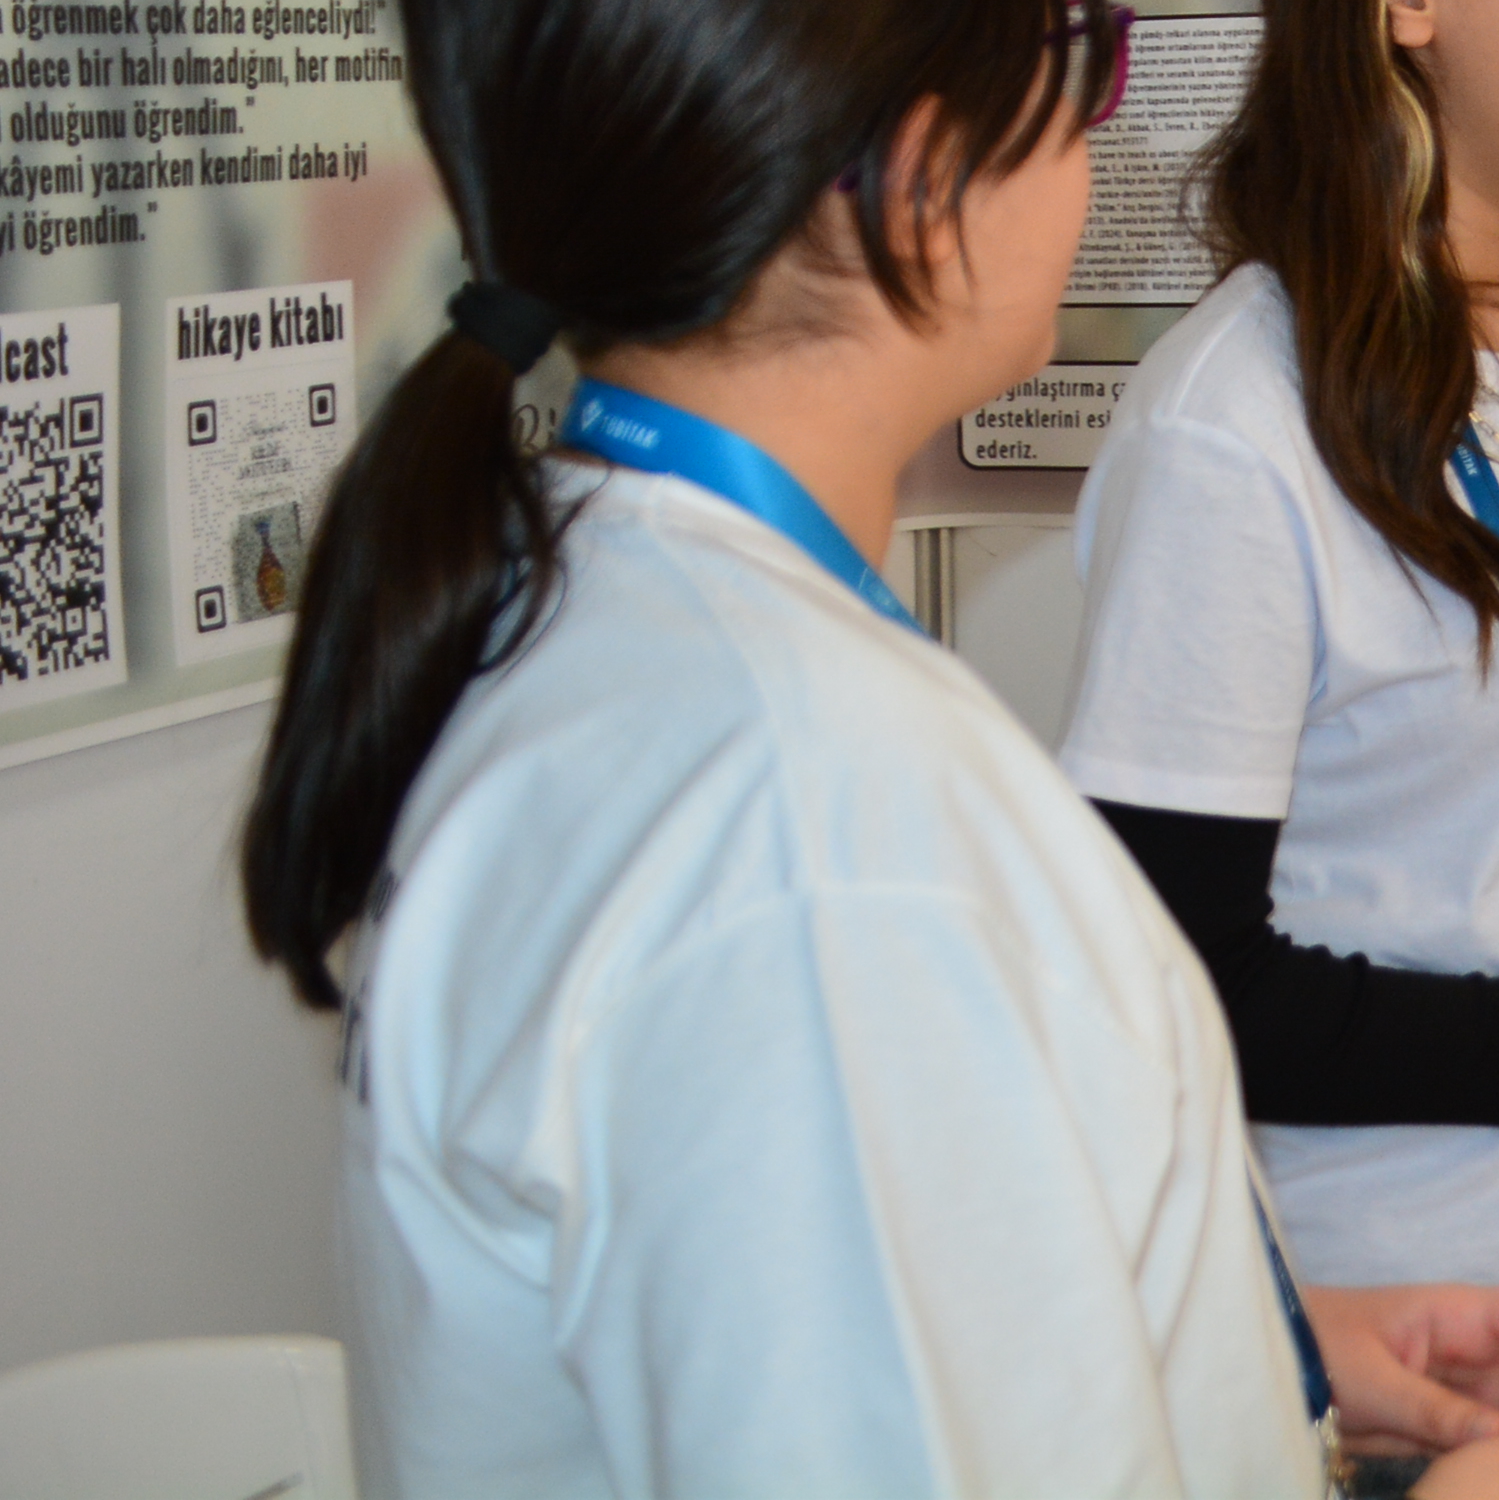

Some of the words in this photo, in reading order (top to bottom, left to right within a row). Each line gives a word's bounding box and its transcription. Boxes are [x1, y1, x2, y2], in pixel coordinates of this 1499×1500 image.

[78, 48, 113, 87] bir
[121, 47, 167, 88] halı
[173, 47, 288, 90] olmadığını,
[296, 47, 328, 82] her
[10, 101, 126, 147] olduğunu
[91, 150, 193, 198] yazarken
[200, 146, 282, 185] kendimi
[289, 143, 338, 180] daha
[344, 142, 367, 182] iyi
[178, 305, 260, 361] hikaye
[270, 293, 343, 348] kitabı
